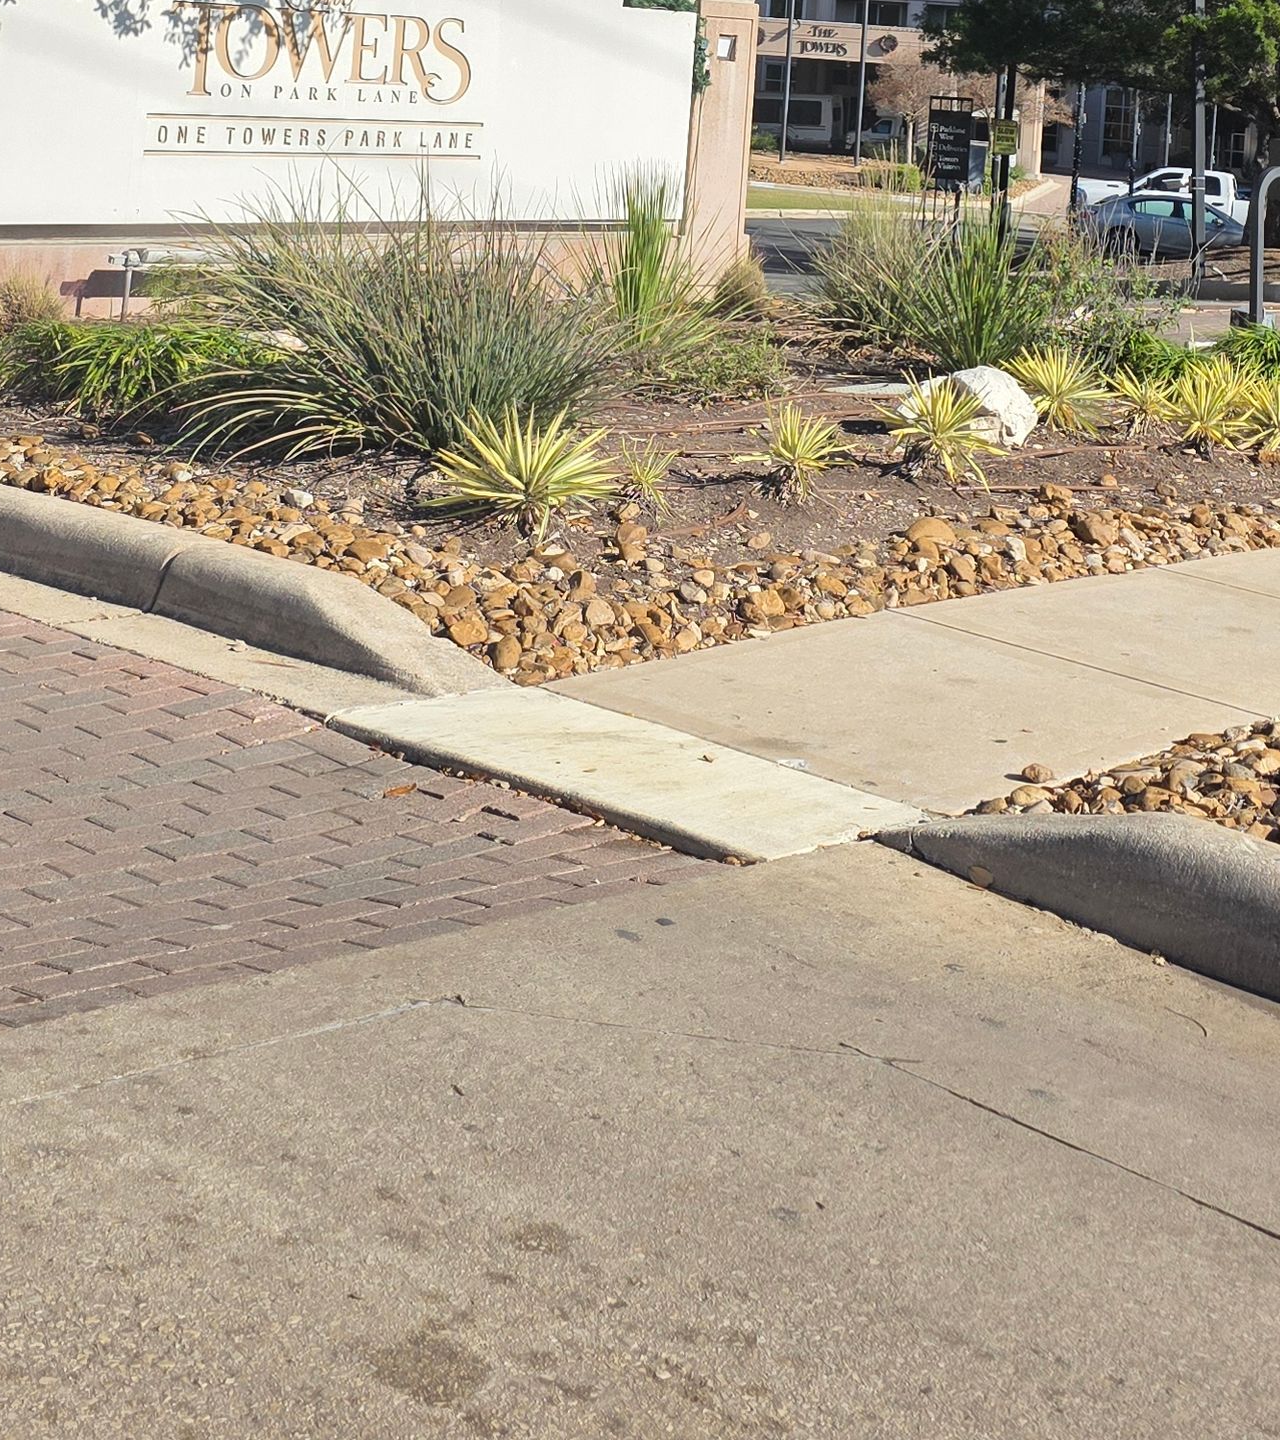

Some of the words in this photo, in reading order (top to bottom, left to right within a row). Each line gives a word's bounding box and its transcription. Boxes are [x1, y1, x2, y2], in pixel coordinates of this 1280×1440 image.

[807, 25, 838, 38] THE
[170, 0, 471, 106] TOWERS
[796, 40, 848, 57] TOWERS
[220, 82, 252, 99] ON
[274, 85, 338, 102] PARK
[357, 88, 419, 104] LANE
[157, 125, 206, 144] ONE
[226, 126, 327, 146] TOWERS
[344, 128, 402, 148] PARK
[419, 131, 473, 149] LANE
